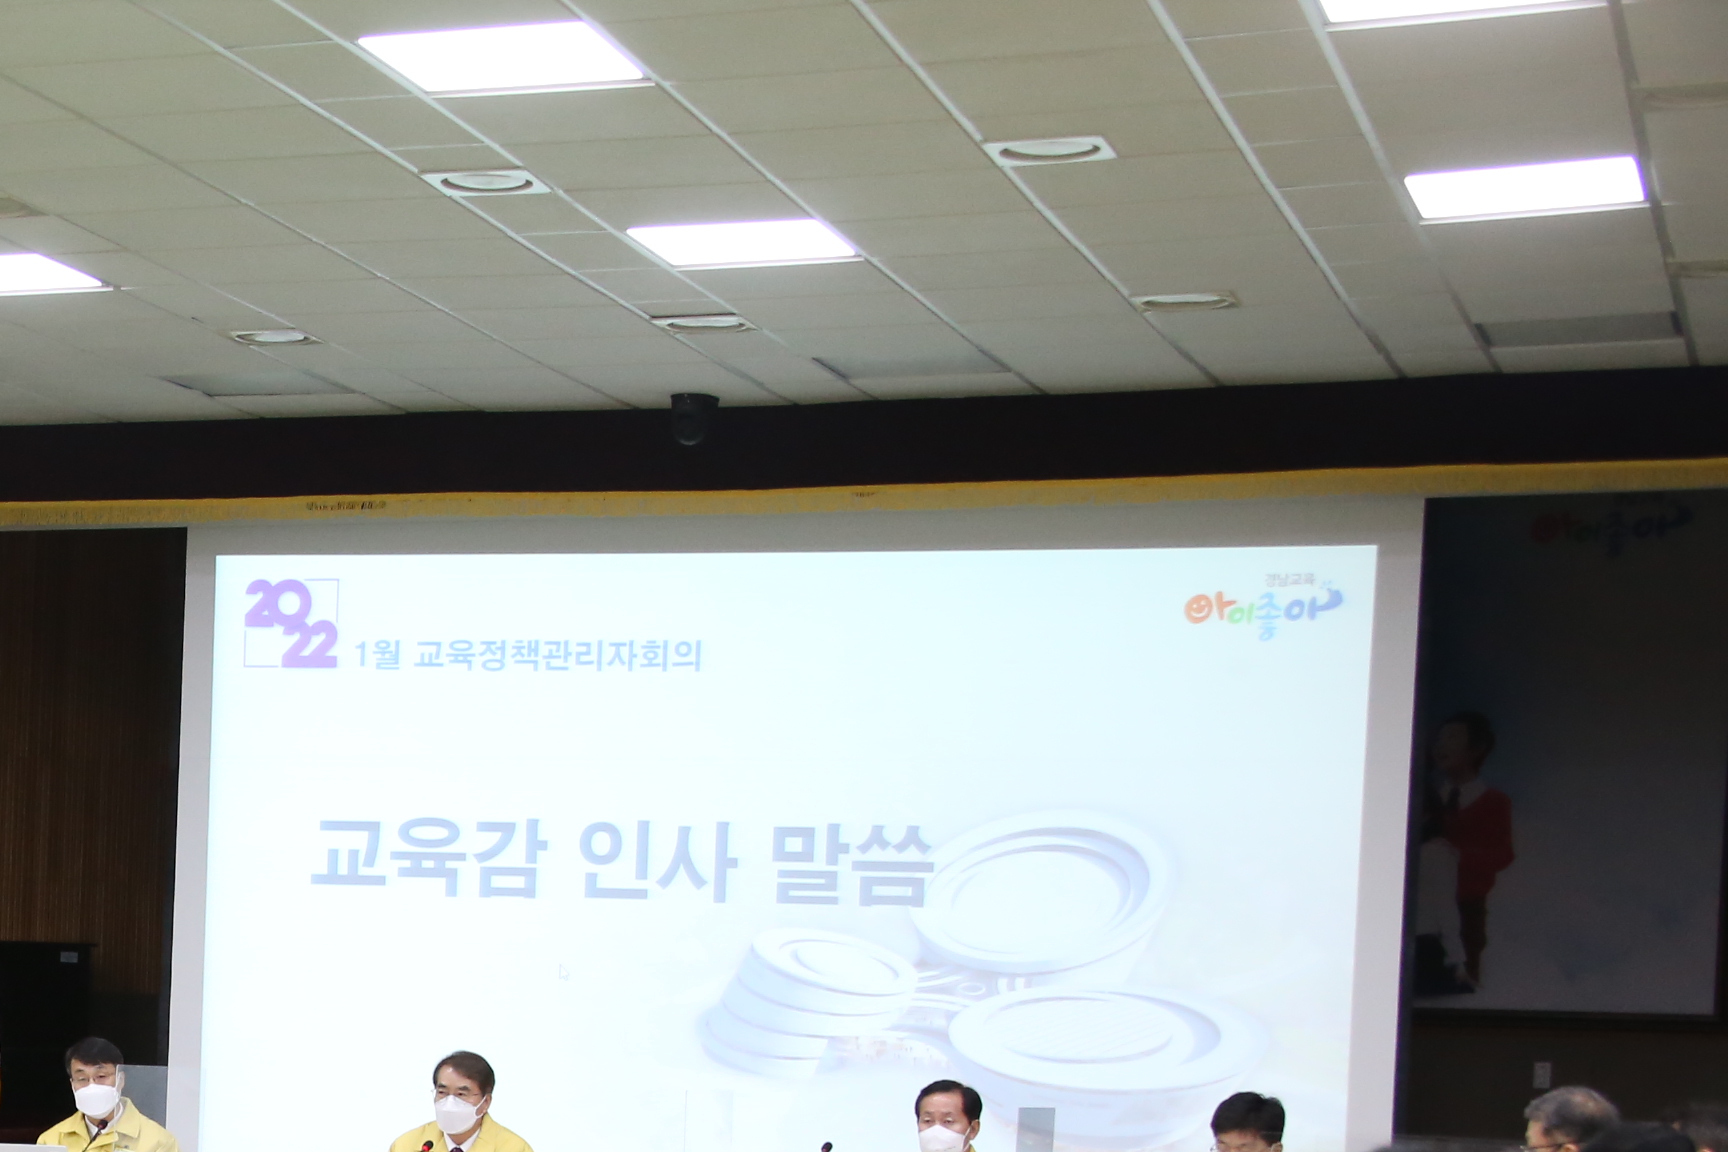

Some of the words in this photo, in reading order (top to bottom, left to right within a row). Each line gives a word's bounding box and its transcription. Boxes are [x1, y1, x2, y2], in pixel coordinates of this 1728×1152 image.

[355, 639, 400, 670] 1월
[414, 639, 702, 672] 교육정책관리자회의
[311, 817, 548, 899] 교육감
[579, 820, 739, 904] 인사
[772, 823, 936, 908] 말씀
